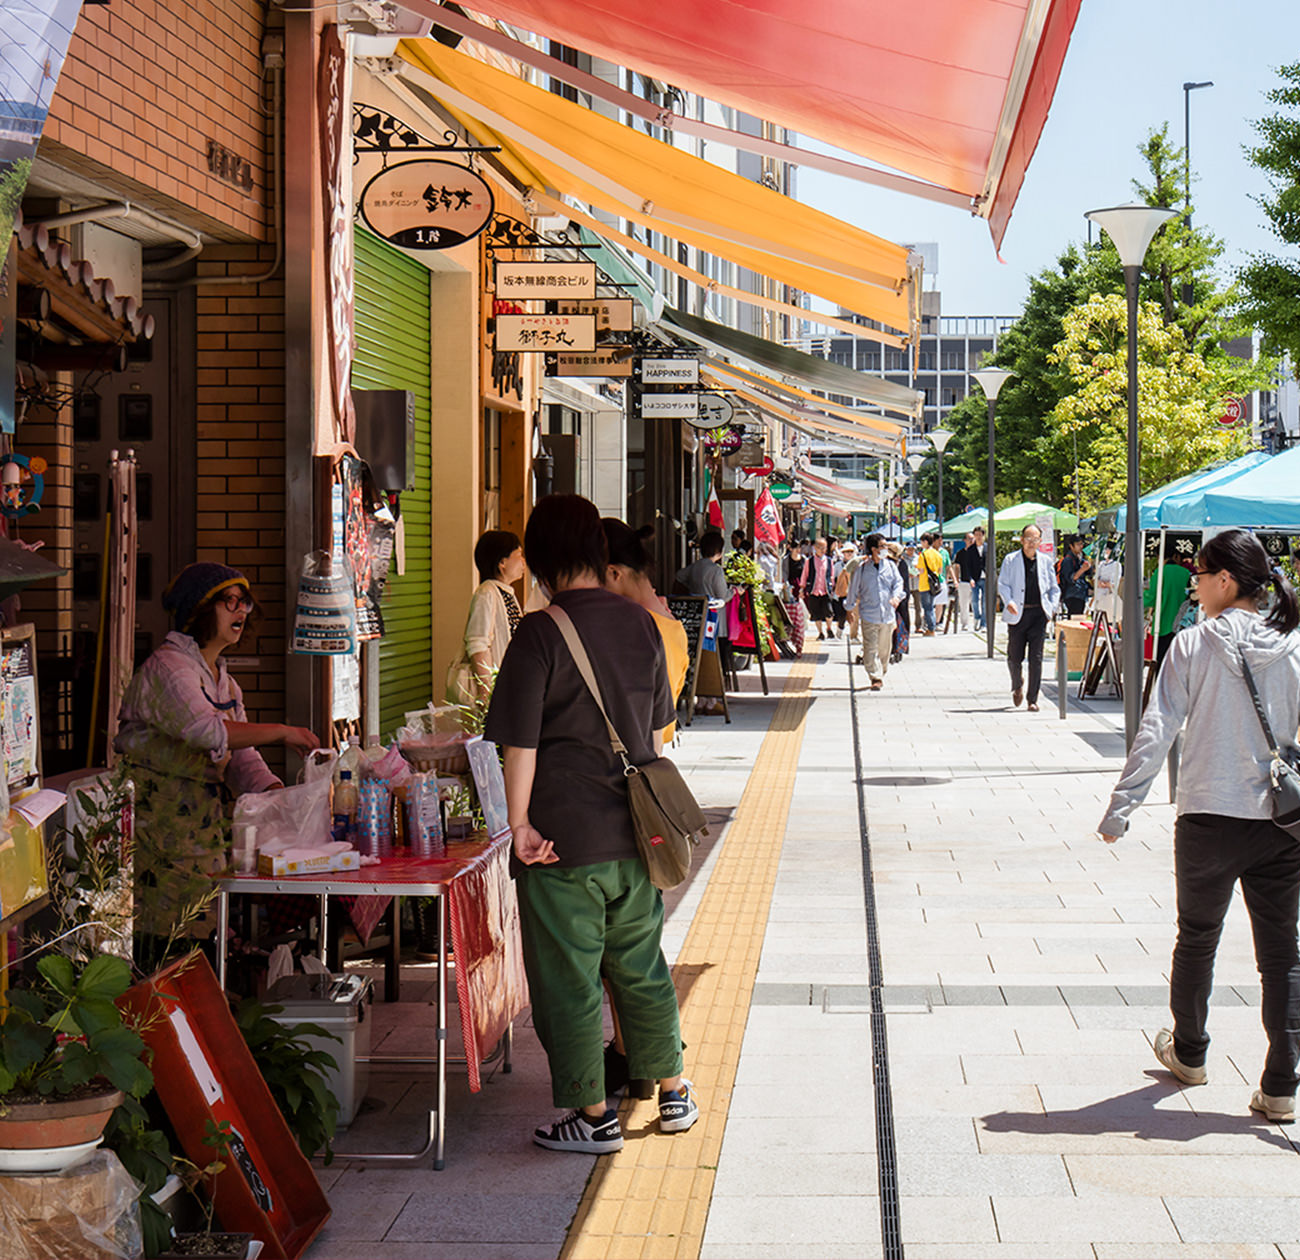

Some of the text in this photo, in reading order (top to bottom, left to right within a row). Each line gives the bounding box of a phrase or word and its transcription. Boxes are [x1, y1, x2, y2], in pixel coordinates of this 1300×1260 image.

[503, 275, 589, 287] 坂本無線商会ビル
[646, 369, 692, 377] HAPPINESS
